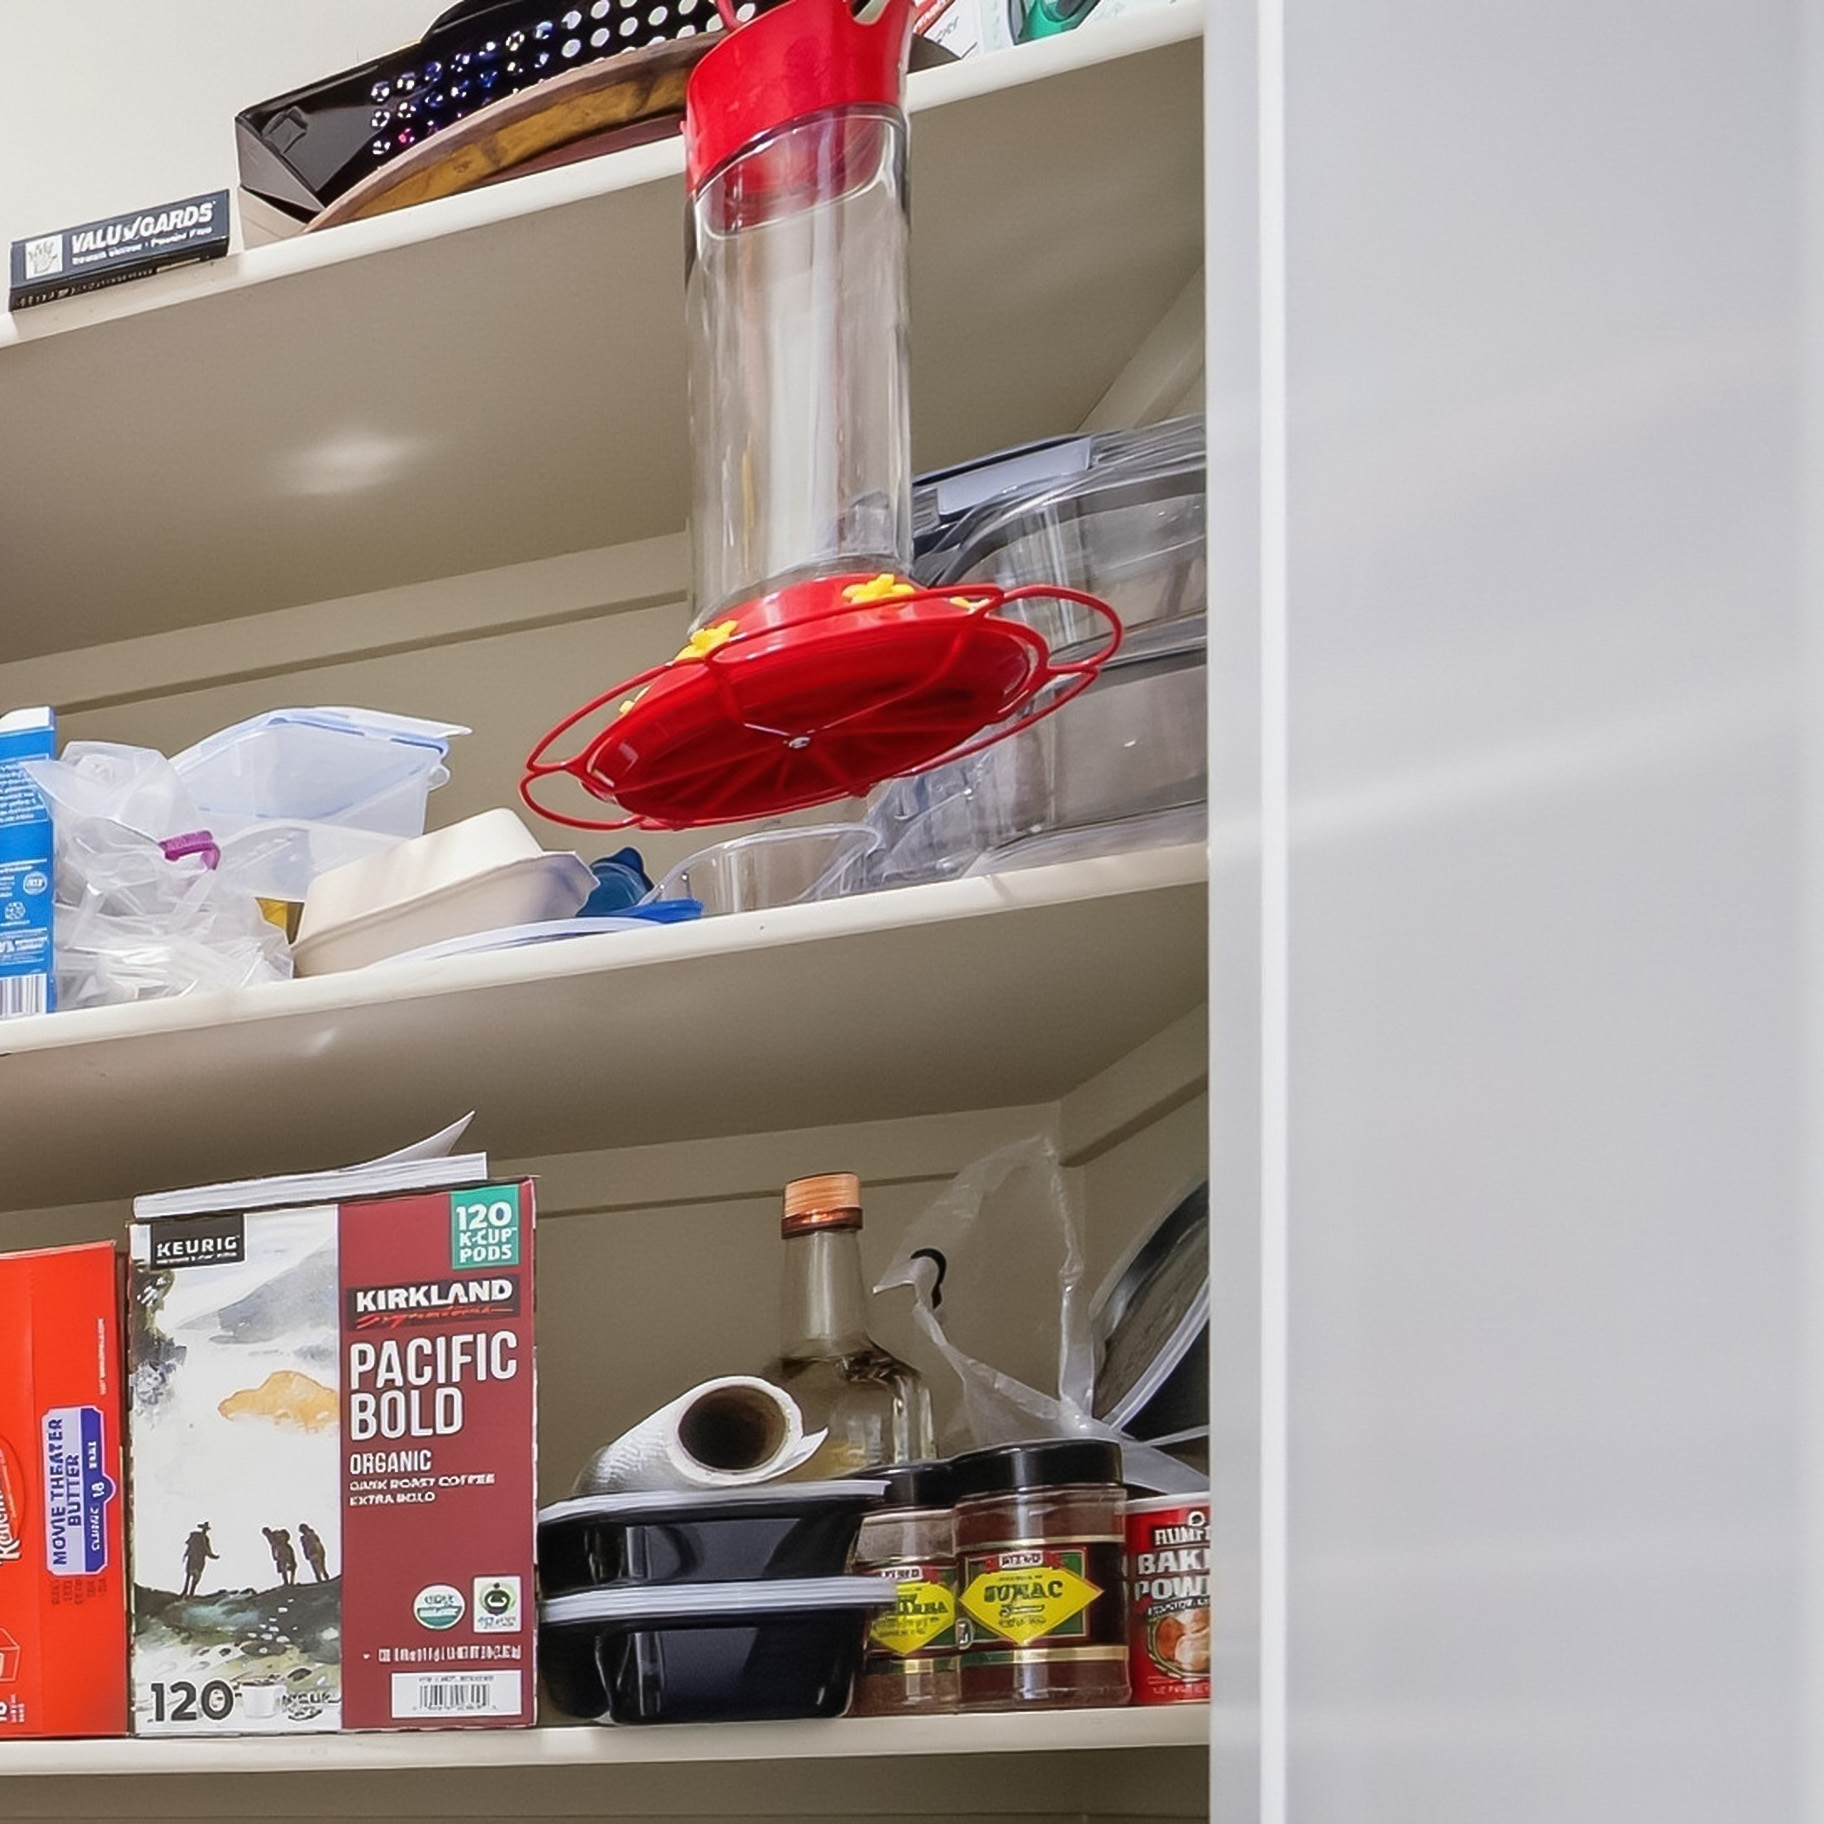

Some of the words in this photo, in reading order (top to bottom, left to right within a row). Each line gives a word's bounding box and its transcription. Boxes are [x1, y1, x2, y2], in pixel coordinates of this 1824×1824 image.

[456, 1201, 514, 1232] 120
[156, 1236, 238, 1259] KEURIG
[458, 1228, 515, 1247] K-CUP
[458, 1243, 514, 1263] PODS
[355, 1278, 514, 1312] KIRKLAND
[348, 1330, 519, 1390] PACIFIC
[349, 1387, 464, 1442] BOLD
[47, 1417, 64, 1510] THEATER
[349, 1450, 432, 1475] ORGANIC
[67, 1454, 82, 1527] BUTTER
[51, 1512, 68, 1566] MOVIE
[150, 1680, 235, 1723] 120
